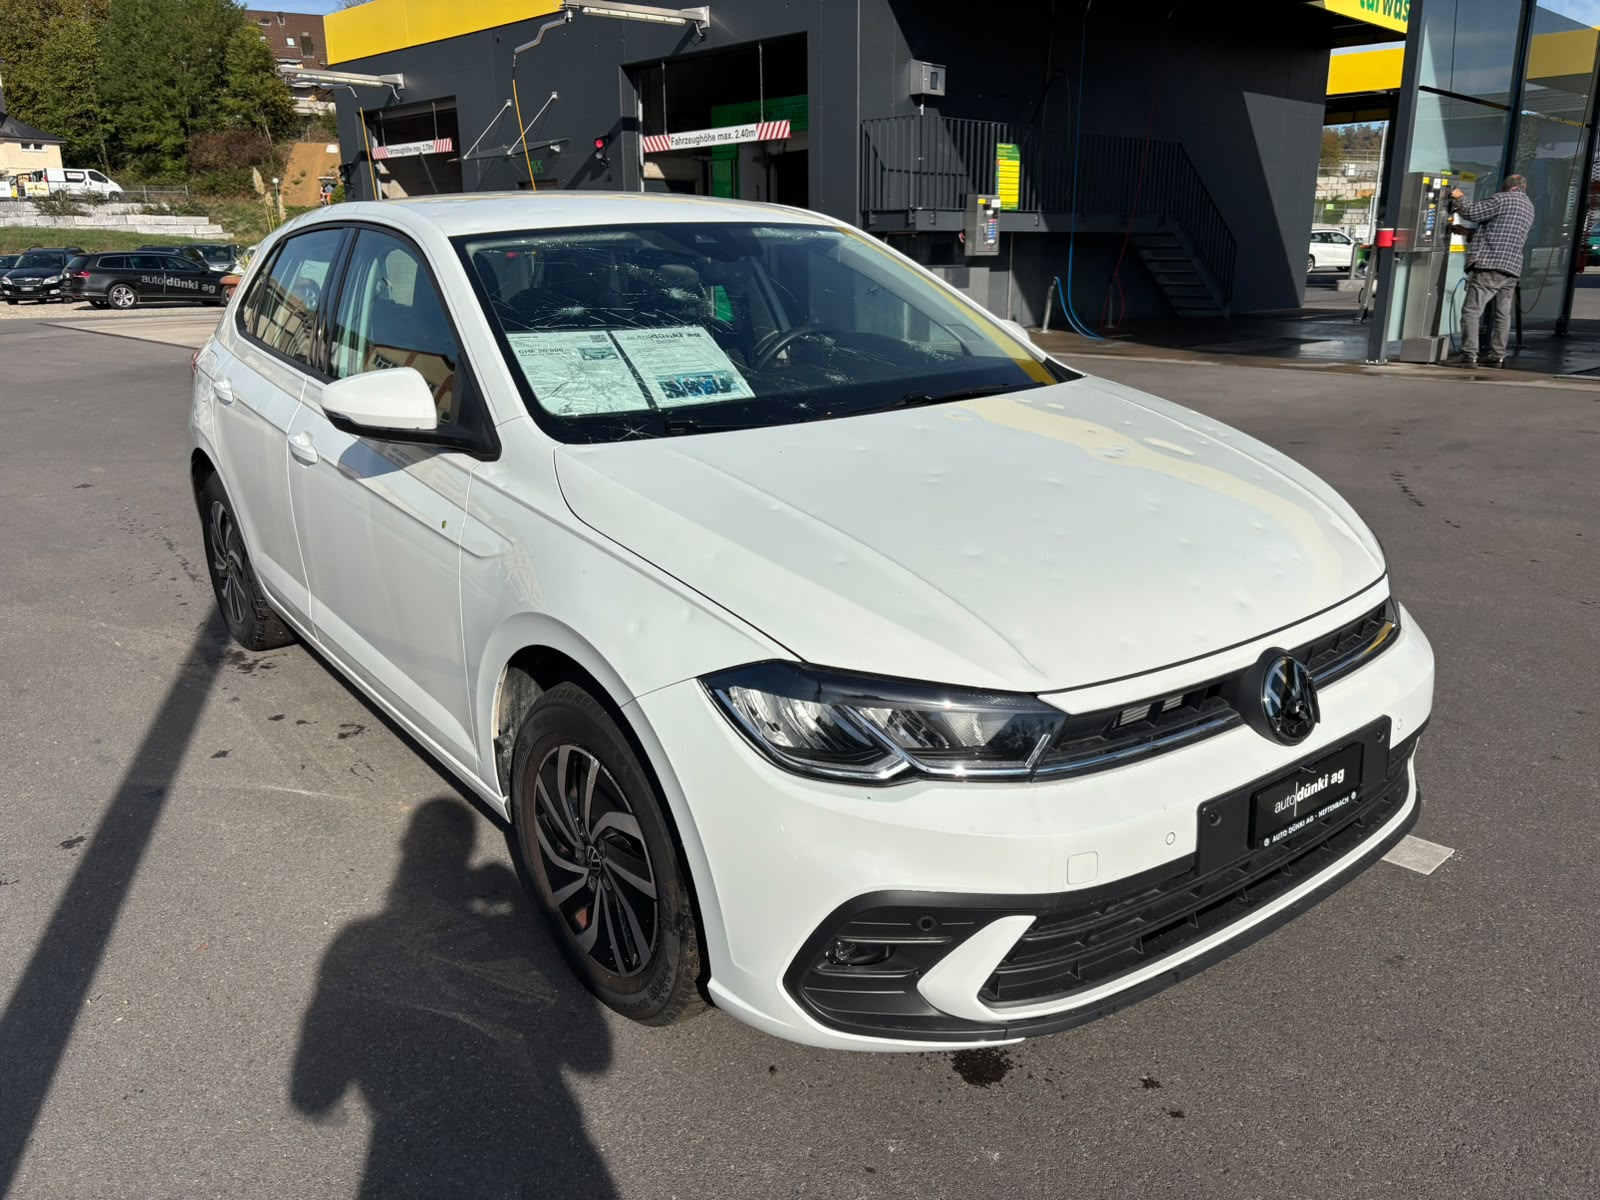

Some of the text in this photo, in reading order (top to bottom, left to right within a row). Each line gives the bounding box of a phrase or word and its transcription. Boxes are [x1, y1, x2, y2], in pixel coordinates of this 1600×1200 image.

[671, 129, 756, 146] Fahrzeughöhe max. 2.40m
[202, 283, 216, 294] ag
[1274, 768, 1345, 814] auto dünki ag
[1272, 830, 1288, 843] AUTO
[1288, 820, 1306, 834] DÜNKI
[1305, 815, 1314, 825] AG
[1318, 796, 1350, 818] NEFTENBACH
